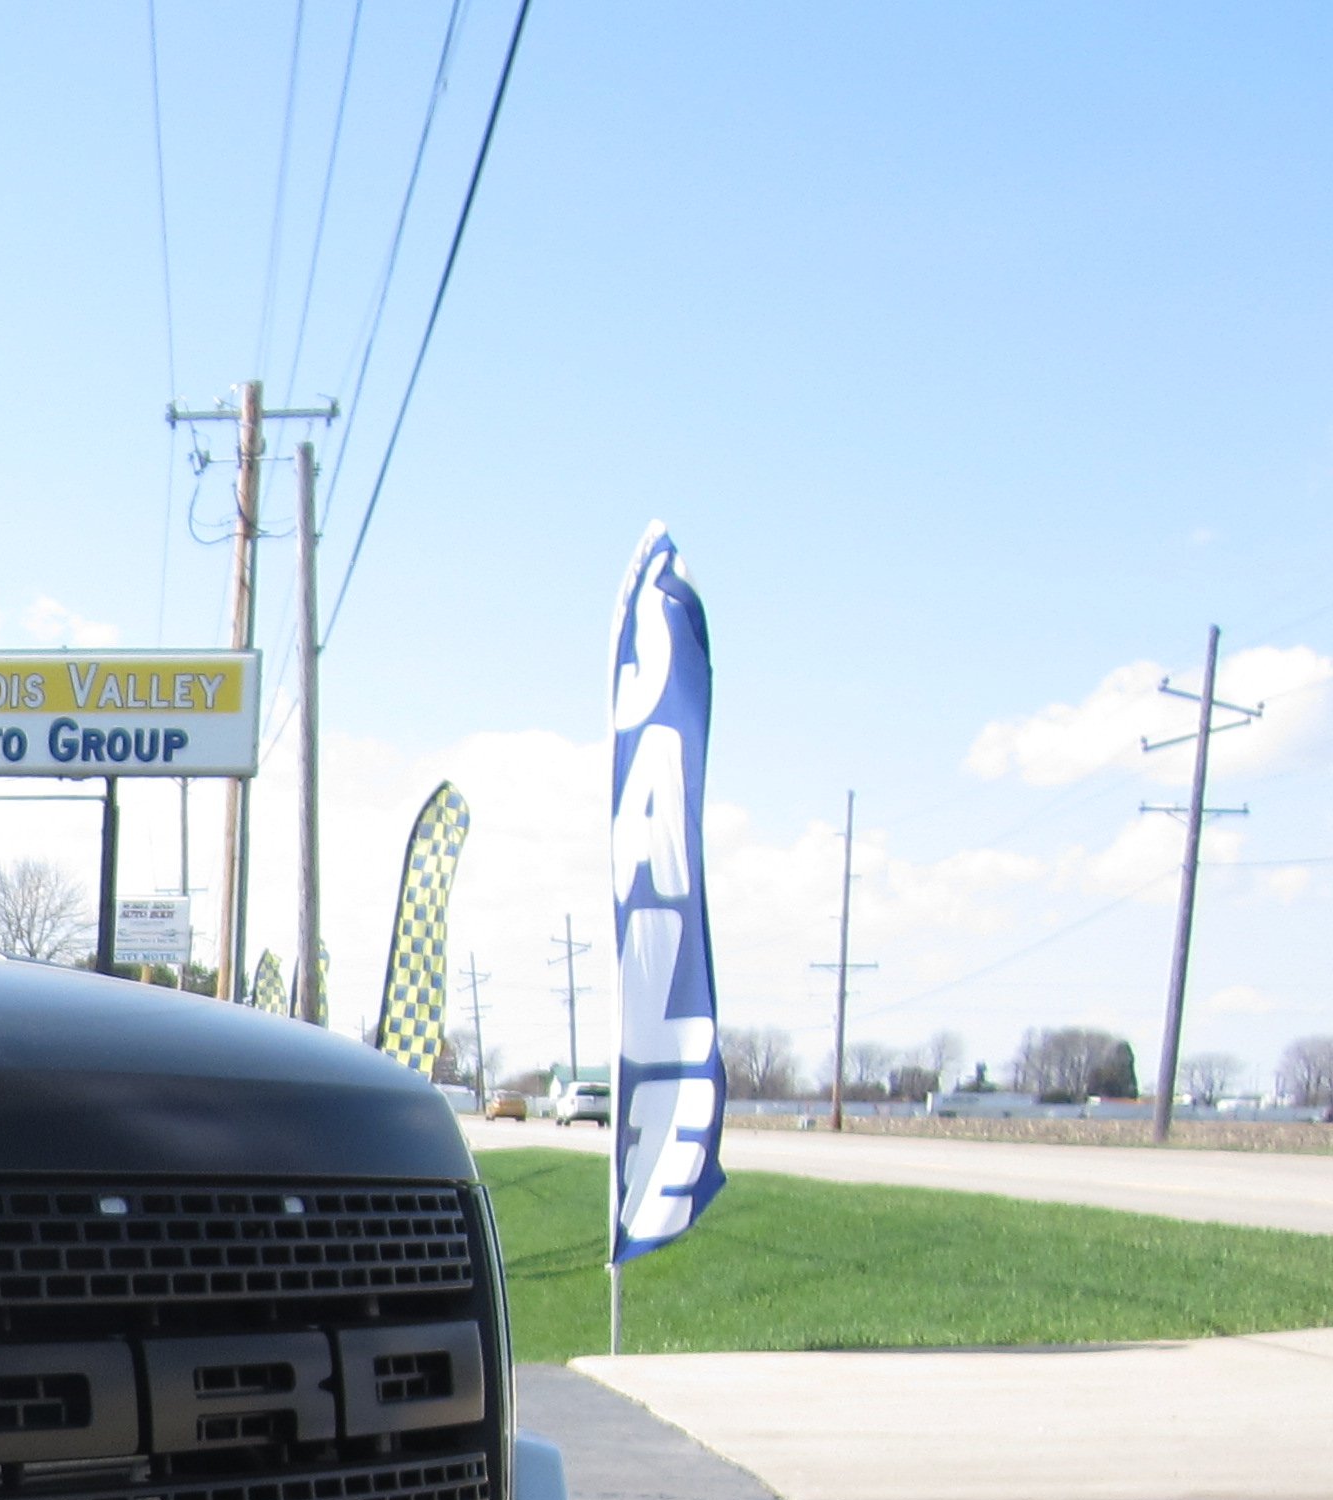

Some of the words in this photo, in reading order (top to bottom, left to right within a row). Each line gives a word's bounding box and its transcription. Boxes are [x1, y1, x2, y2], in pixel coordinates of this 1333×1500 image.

[67, 662, 226, 710] VALLEY
[48, 716, 190, 763] GROUP
[611, 550, 717, 1242] SALE
